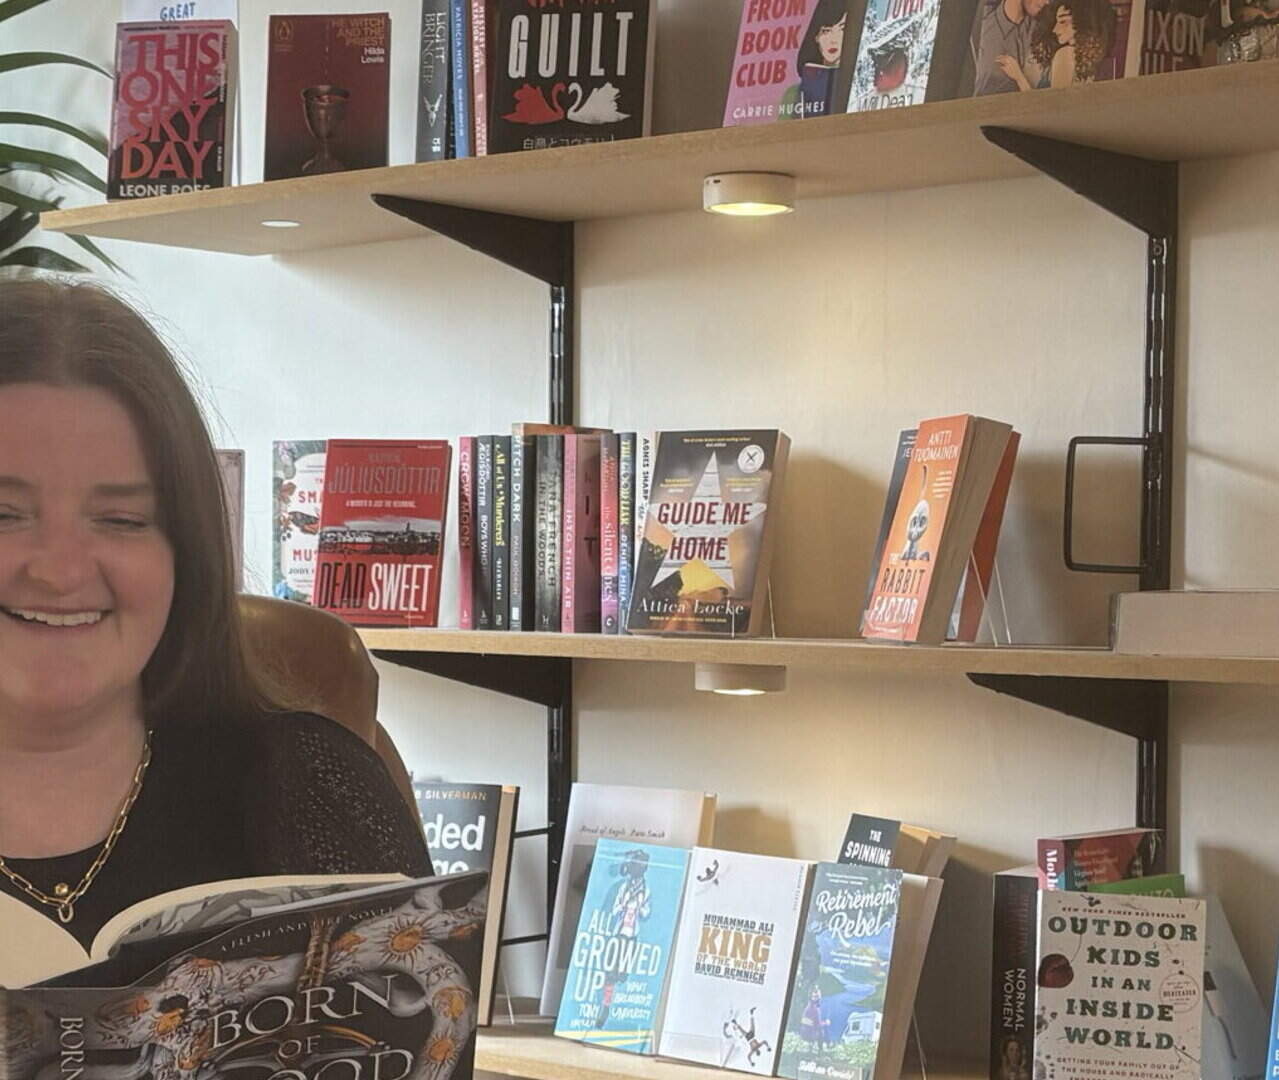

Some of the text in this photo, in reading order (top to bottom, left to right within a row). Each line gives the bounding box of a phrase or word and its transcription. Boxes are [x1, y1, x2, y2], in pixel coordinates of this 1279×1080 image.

[160, 2, 195, 20] GREAT
[349, 18, 385, 28] WITCH
[746, 0, 807, 24] FROM
[336, 28, 385, 38] AND THE
[345, 37, 385, 47] PRIEST
[508, 12, 633, 78] GUILT
[740, 24, 802, 56] BOOK
[127, 32, 220, 71] THIS
[360, 55, 385, 64] Lewis
[423, 12, 436, 85] BRINGER
[735, 60, 788, 88] CLUB
[120, 69, 218, 106] ONE
[127, 99, 218, 143] SKY
[733, 100, 825, 119] CARRIE HUGHES
[120, 140, 215, 180] DAY
[119, 184, 168, 198] LEONE
[928, 430, 952, 445] ANTTI
[512, 435, 522, 522] PITCH DARK
[641, 438, 650, 501] AGNES SHARP
[460, 451, 471, 549] CROW MOON
[658, 502, 753, 525] GUIDE ME
[480, 515, 488, 541] BOYS
[537, 480, 547, 577] IN THE WOODS
[547, 519, 557, 588] FRENCH
[603, 522, 615, 562] silent
[670, 537, 729, 561] HOME
[563, 509, 572, 609] INTO THIN AIR
[319, 563, 433, 612] DEAD SWEET
[880, 568, 925, 594] RABBIT
[636, 597, 744, 616] Attica Locke
[869, 596, 919, 624] FACTOR
[425, 790, 488, 801] SILVERMAN
[869, 830, 882, 842] THE
[845, 841, 891, 866] SPINNING
[816, 884, 898, 913] Retirement
[588, 909, 613, 936] ALL
[703, 913, 774, 933] MUHAMMAD ALI
[828, 909, 892, 947] Rebel
[1048, 916, 1198, 942] OUTDOOR
[573, 934, 662, 977] GROWED
[699, 926, 772, 963] KING
[1087, 946, 1161, 968] KIDS
[695, 962, 765, 981] DAVID REMNICK
[711, 956, 767, 972] THE WORLD
[574, 969, 606, 1002] UP
[1091, 976, 1152, 991] IN AN
[1003, 968, 1014, 1029] WOMEN
[1014, 967, 1026, 1032] NORMAL
[1066, 998, 1174, 1021] INSIDE
[206, 974, 397, 1051] BORN
[276, 1034, 322, 1059] OF
[1064, 1027, 1174, 1050] WORLD
